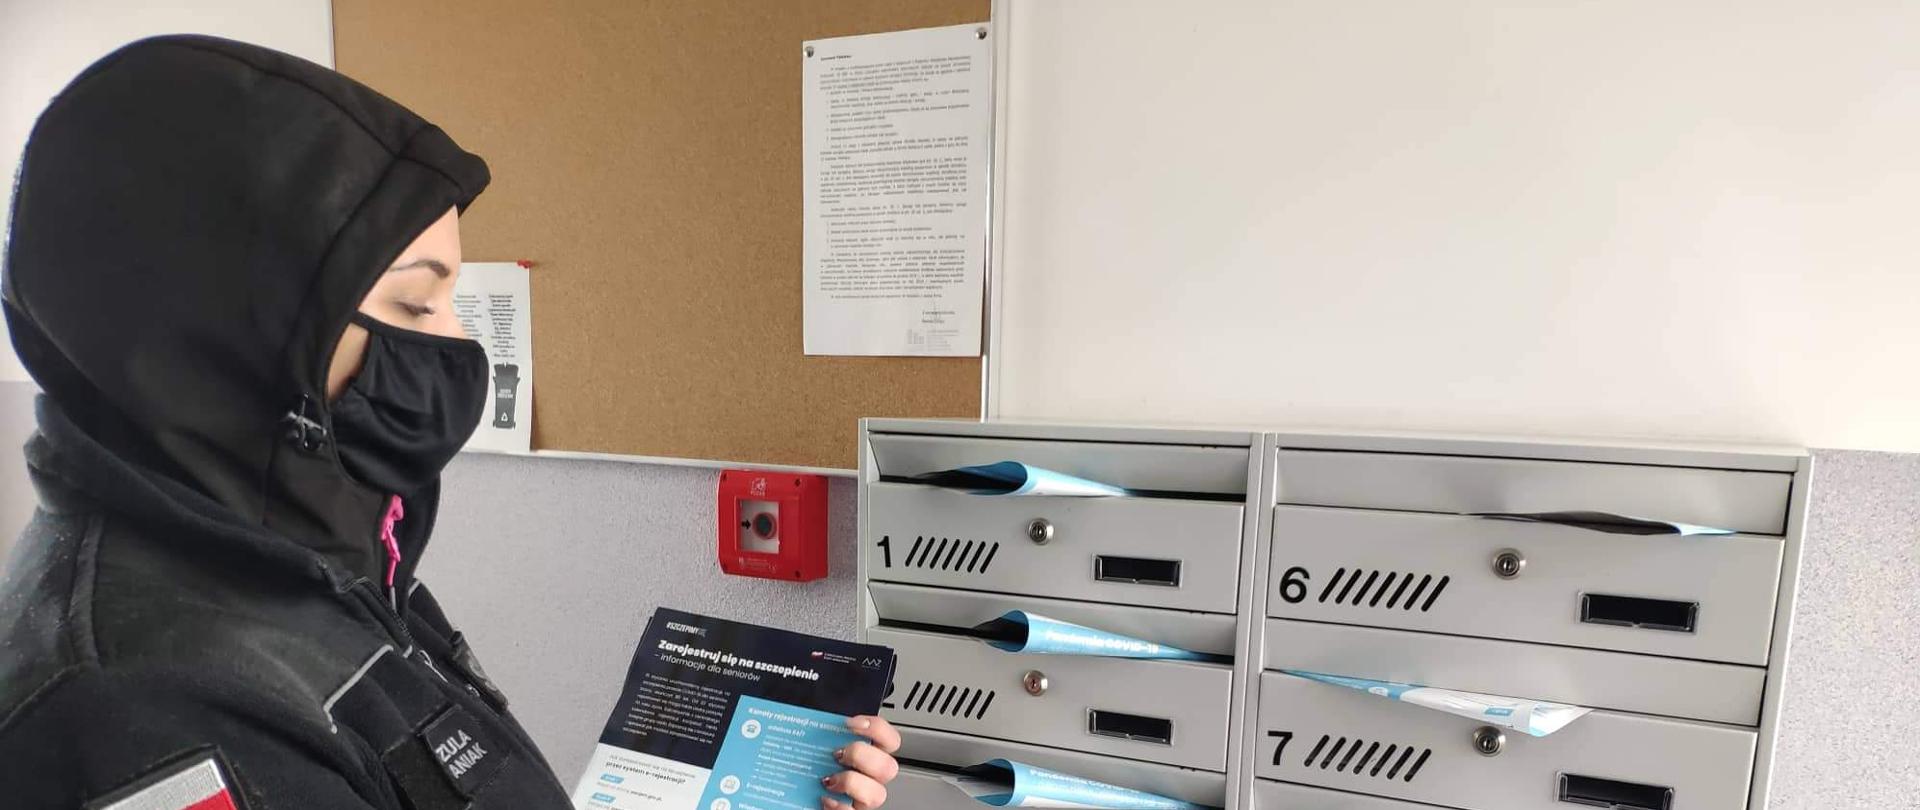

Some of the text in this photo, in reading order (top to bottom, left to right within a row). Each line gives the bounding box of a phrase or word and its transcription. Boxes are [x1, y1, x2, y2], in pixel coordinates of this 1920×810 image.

[877, 535, 892, 568] 1
[1279, 566, 1310, 604] 6
[658, 639, 820, 682] Zarejestruj się na szczepienie
[660, 652, 706, 671] informacje
[707, 662, 722, 674] dla
[722, 668, 761, 682] seniorów
[435, 729, 472, 762] ZULA
[448, 742, 488, 779] ANIAK
[1267, 730, 1294, 766] 7
